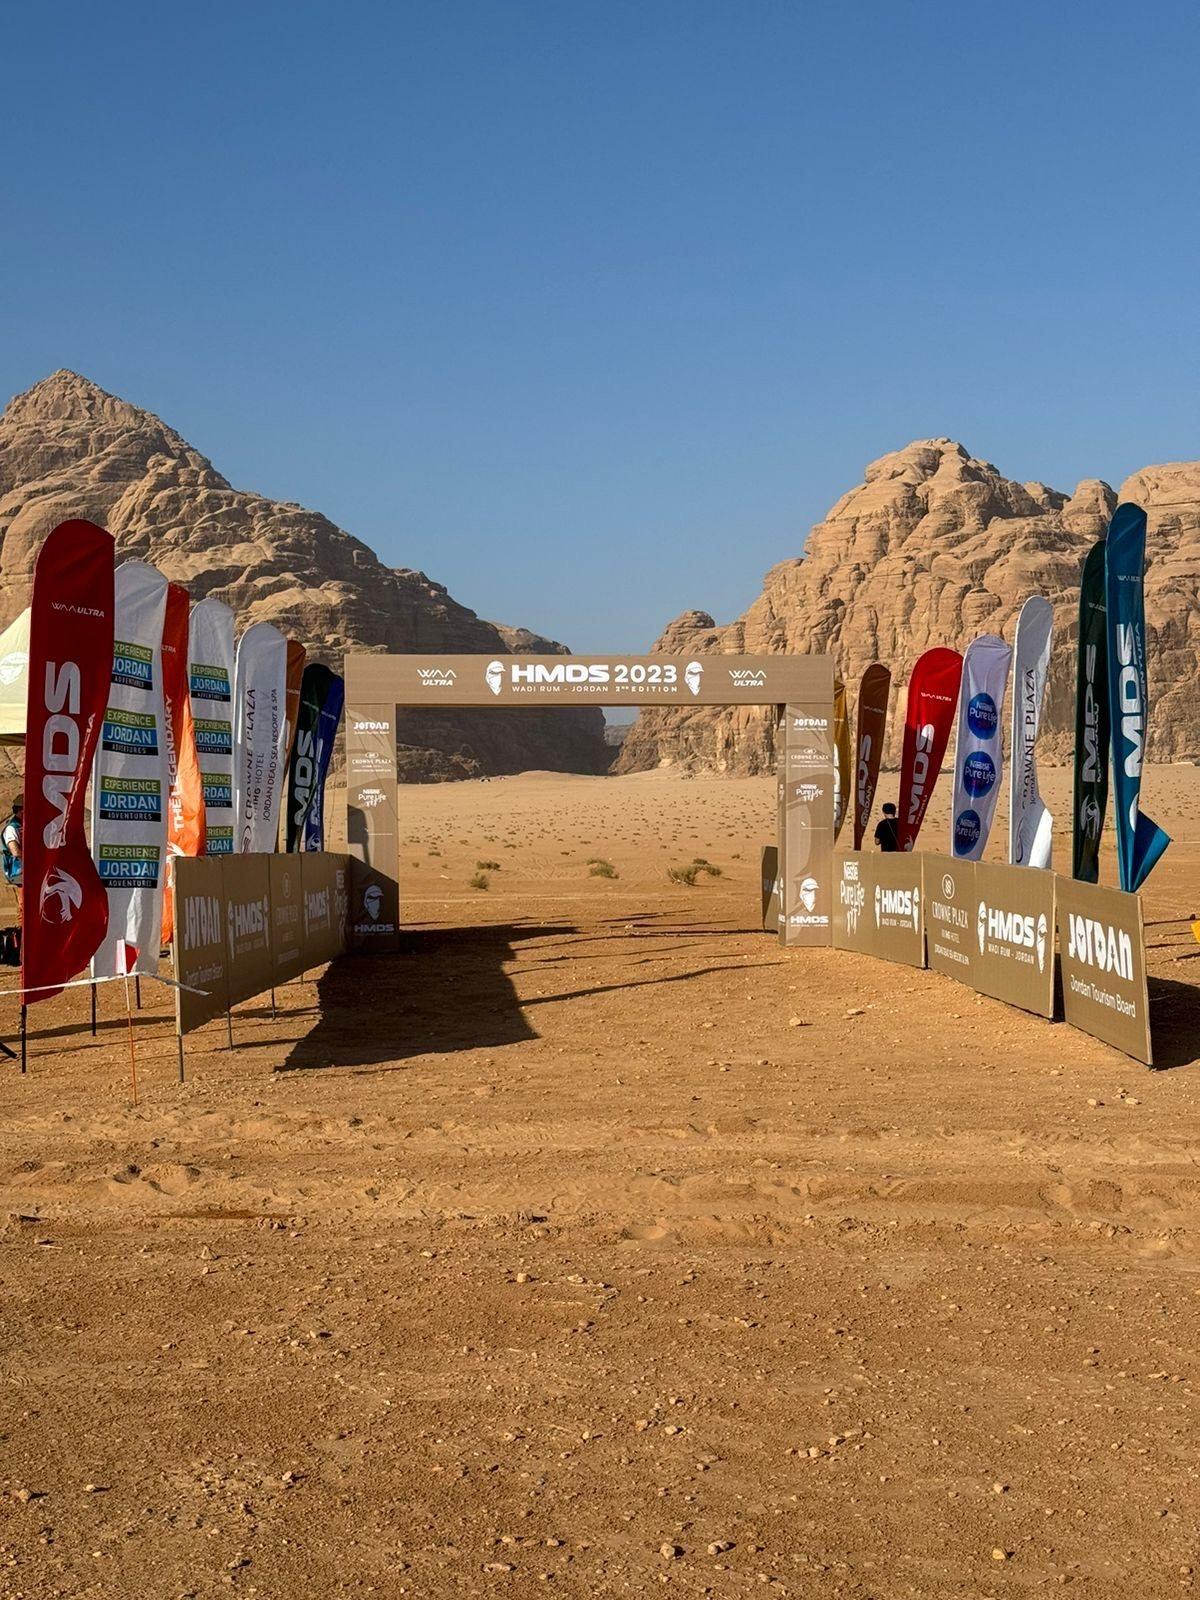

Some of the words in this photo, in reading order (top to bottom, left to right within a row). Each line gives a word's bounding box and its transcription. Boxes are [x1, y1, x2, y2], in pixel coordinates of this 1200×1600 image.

[77, 606, 105, 618] ULTRA
[114, 643, 151, 661] XPERIENCE
[511, 664, 610, 683] HMDS
[614, 664, 678, 683] 2023
[194, 678, 226, 693] JORDAN
[1024, 669, 1035, 725] PLAZA
[1116, 622, 1143, 778] MDS
[106, 710, 152, 726] EXPERIENCE
[1082, 644, 1097, 782] MDS
[107, 725, 152, 745] JORDAN
[43, 661, 80, 850] MDS
[270, 745, 278, 760] SEA
[203, 774, 231, 785] ERIENCE
[267, 762, 277, 785] DEAD
[908, 723, 935, 825] MDS
[1022, 734, 1035, 810] ROWNE
[103, 778, 158, 793] EXPERIENCE
[203, 787, 231, 798] RDAN
[104, 793, 158, 810] JORDAN
[263, 786, 273, 822] JORDAN
[107, 811, 153, 821] ADVENTURES
[102, 846, 158, 858] EXPERIENCE
[207, 840, 230, 852] RDAN
[103, 861, 156, 877] JORDAN
[881, 889, 912, 916] HMDS
[790, 916, 829, 924] HMDS
[952, 907, 968, 929] PLAZA
[354, 924, 395, 933] HMDS
[988, 908, 1035, 948] HMDS
[1070, 974, 1092, 998] Jordan
[1091, 982, 1116, 1009] Tourism
[1115, 994, 1136, 1018] Board
